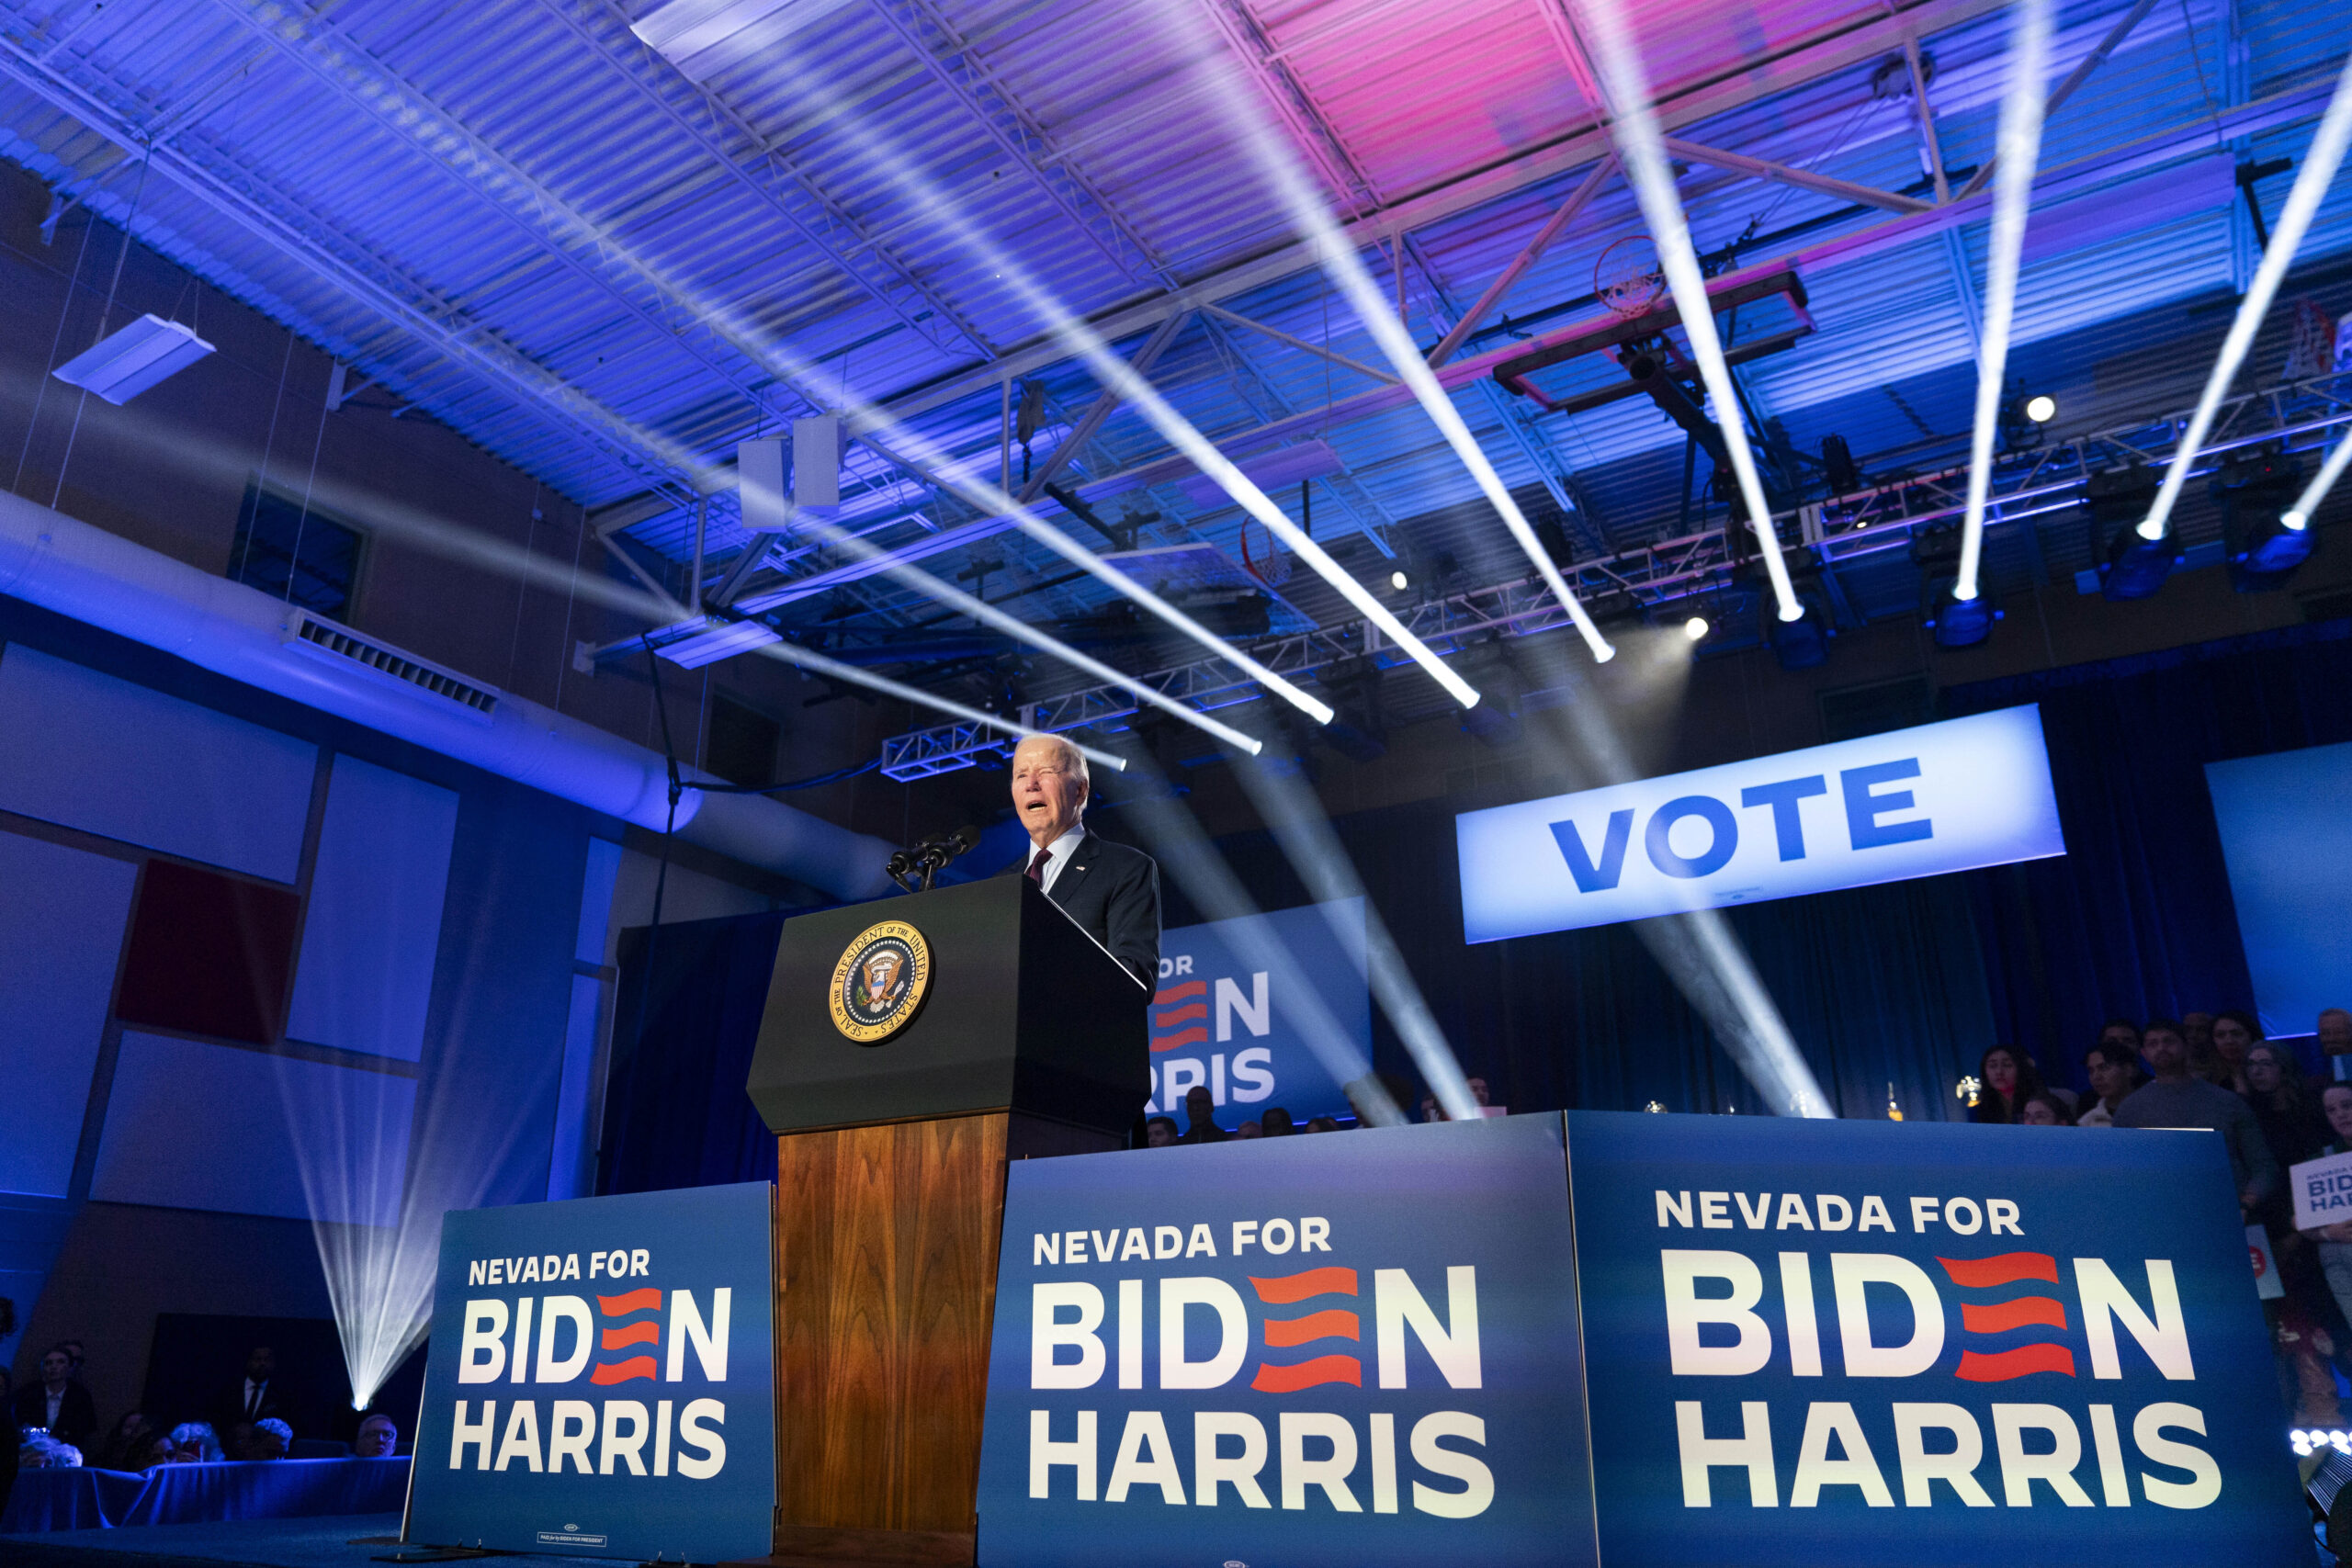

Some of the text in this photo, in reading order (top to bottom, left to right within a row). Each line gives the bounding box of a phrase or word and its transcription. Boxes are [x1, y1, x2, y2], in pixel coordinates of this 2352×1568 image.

[1549, 758, 1934, 894] VOTE
[887, 926, 895, 934] OF
[897, 927, 909, 937] THE
[835, 927, 884, 984] PRESIDENT
[910, 934, 926, 981] UNITED
[1159, 954, 1193, 978] OR
[835, 1006, 842, 1016] OF
[841, 1014, 863, 1037] SEAL
[880, 993, 918, 1033] STATES
[2307, 1175, 2352, 1197] BID
[1655, 1190, 2025, 1235] NEVADA FOR
[1033, 1216, 1333, 1266] NEVADA FOR
[469, 1248, 650, 1286] NEVADA FOR
[458, 1287, 732, 1386] BIDEN
[1030, 1265, 1483, 1393] BIDEN
[1660, 1248, 2197, 1382] BIDEN
[449, 1397, 728, 1480] HARRIS
[1675, 1401, 2222, 1510] HARRIS
[1029, 1410, 1496, 1519] HARRIS
